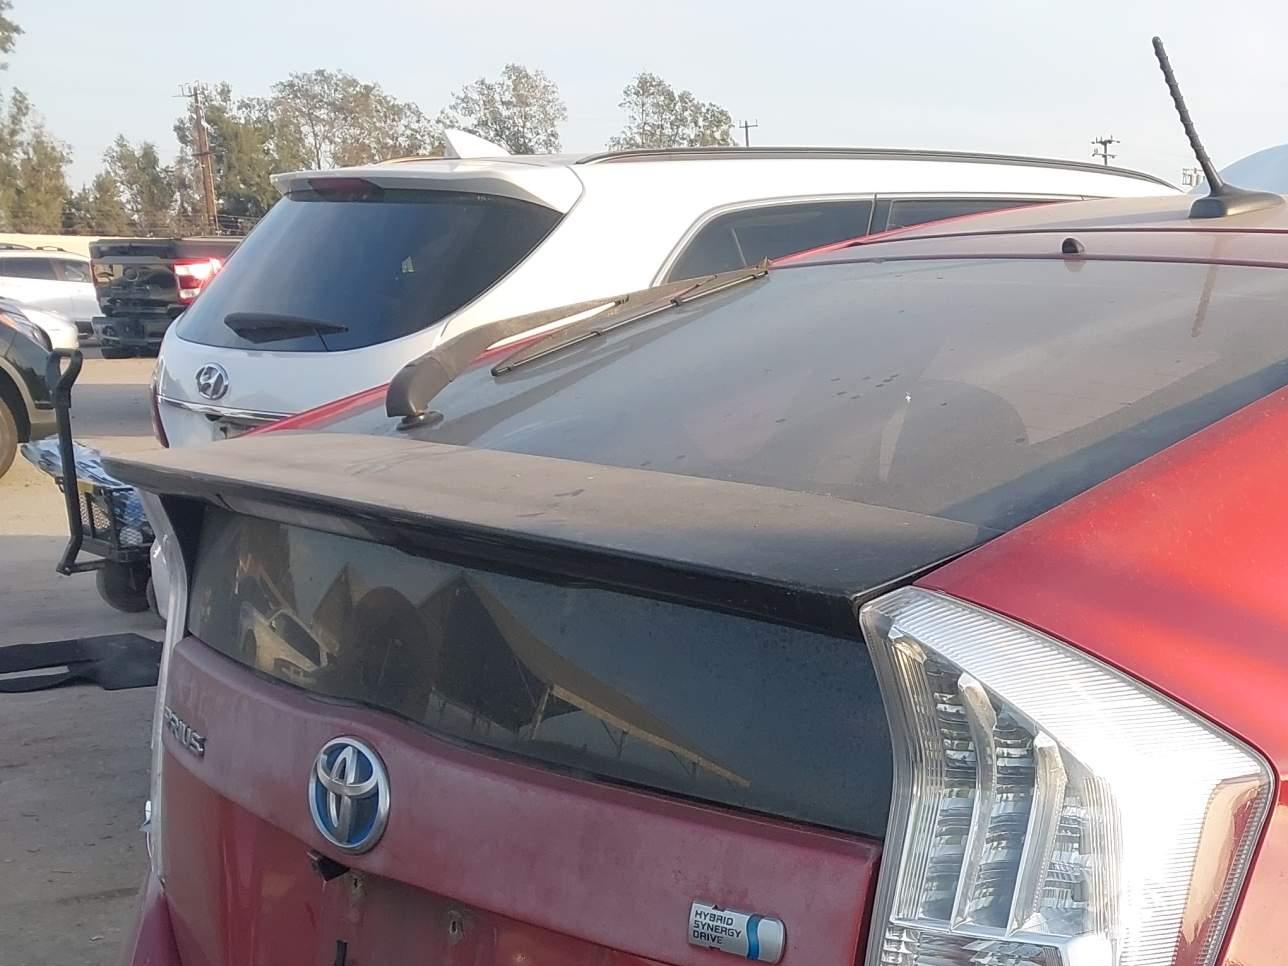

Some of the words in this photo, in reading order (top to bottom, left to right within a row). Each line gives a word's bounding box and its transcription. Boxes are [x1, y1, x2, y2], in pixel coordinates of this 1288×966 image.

[695, 910, 733, 926] HYBRID
[693, 920, 742, 938] SYNERGY
[693, 930, 724, 944] DRIVE
